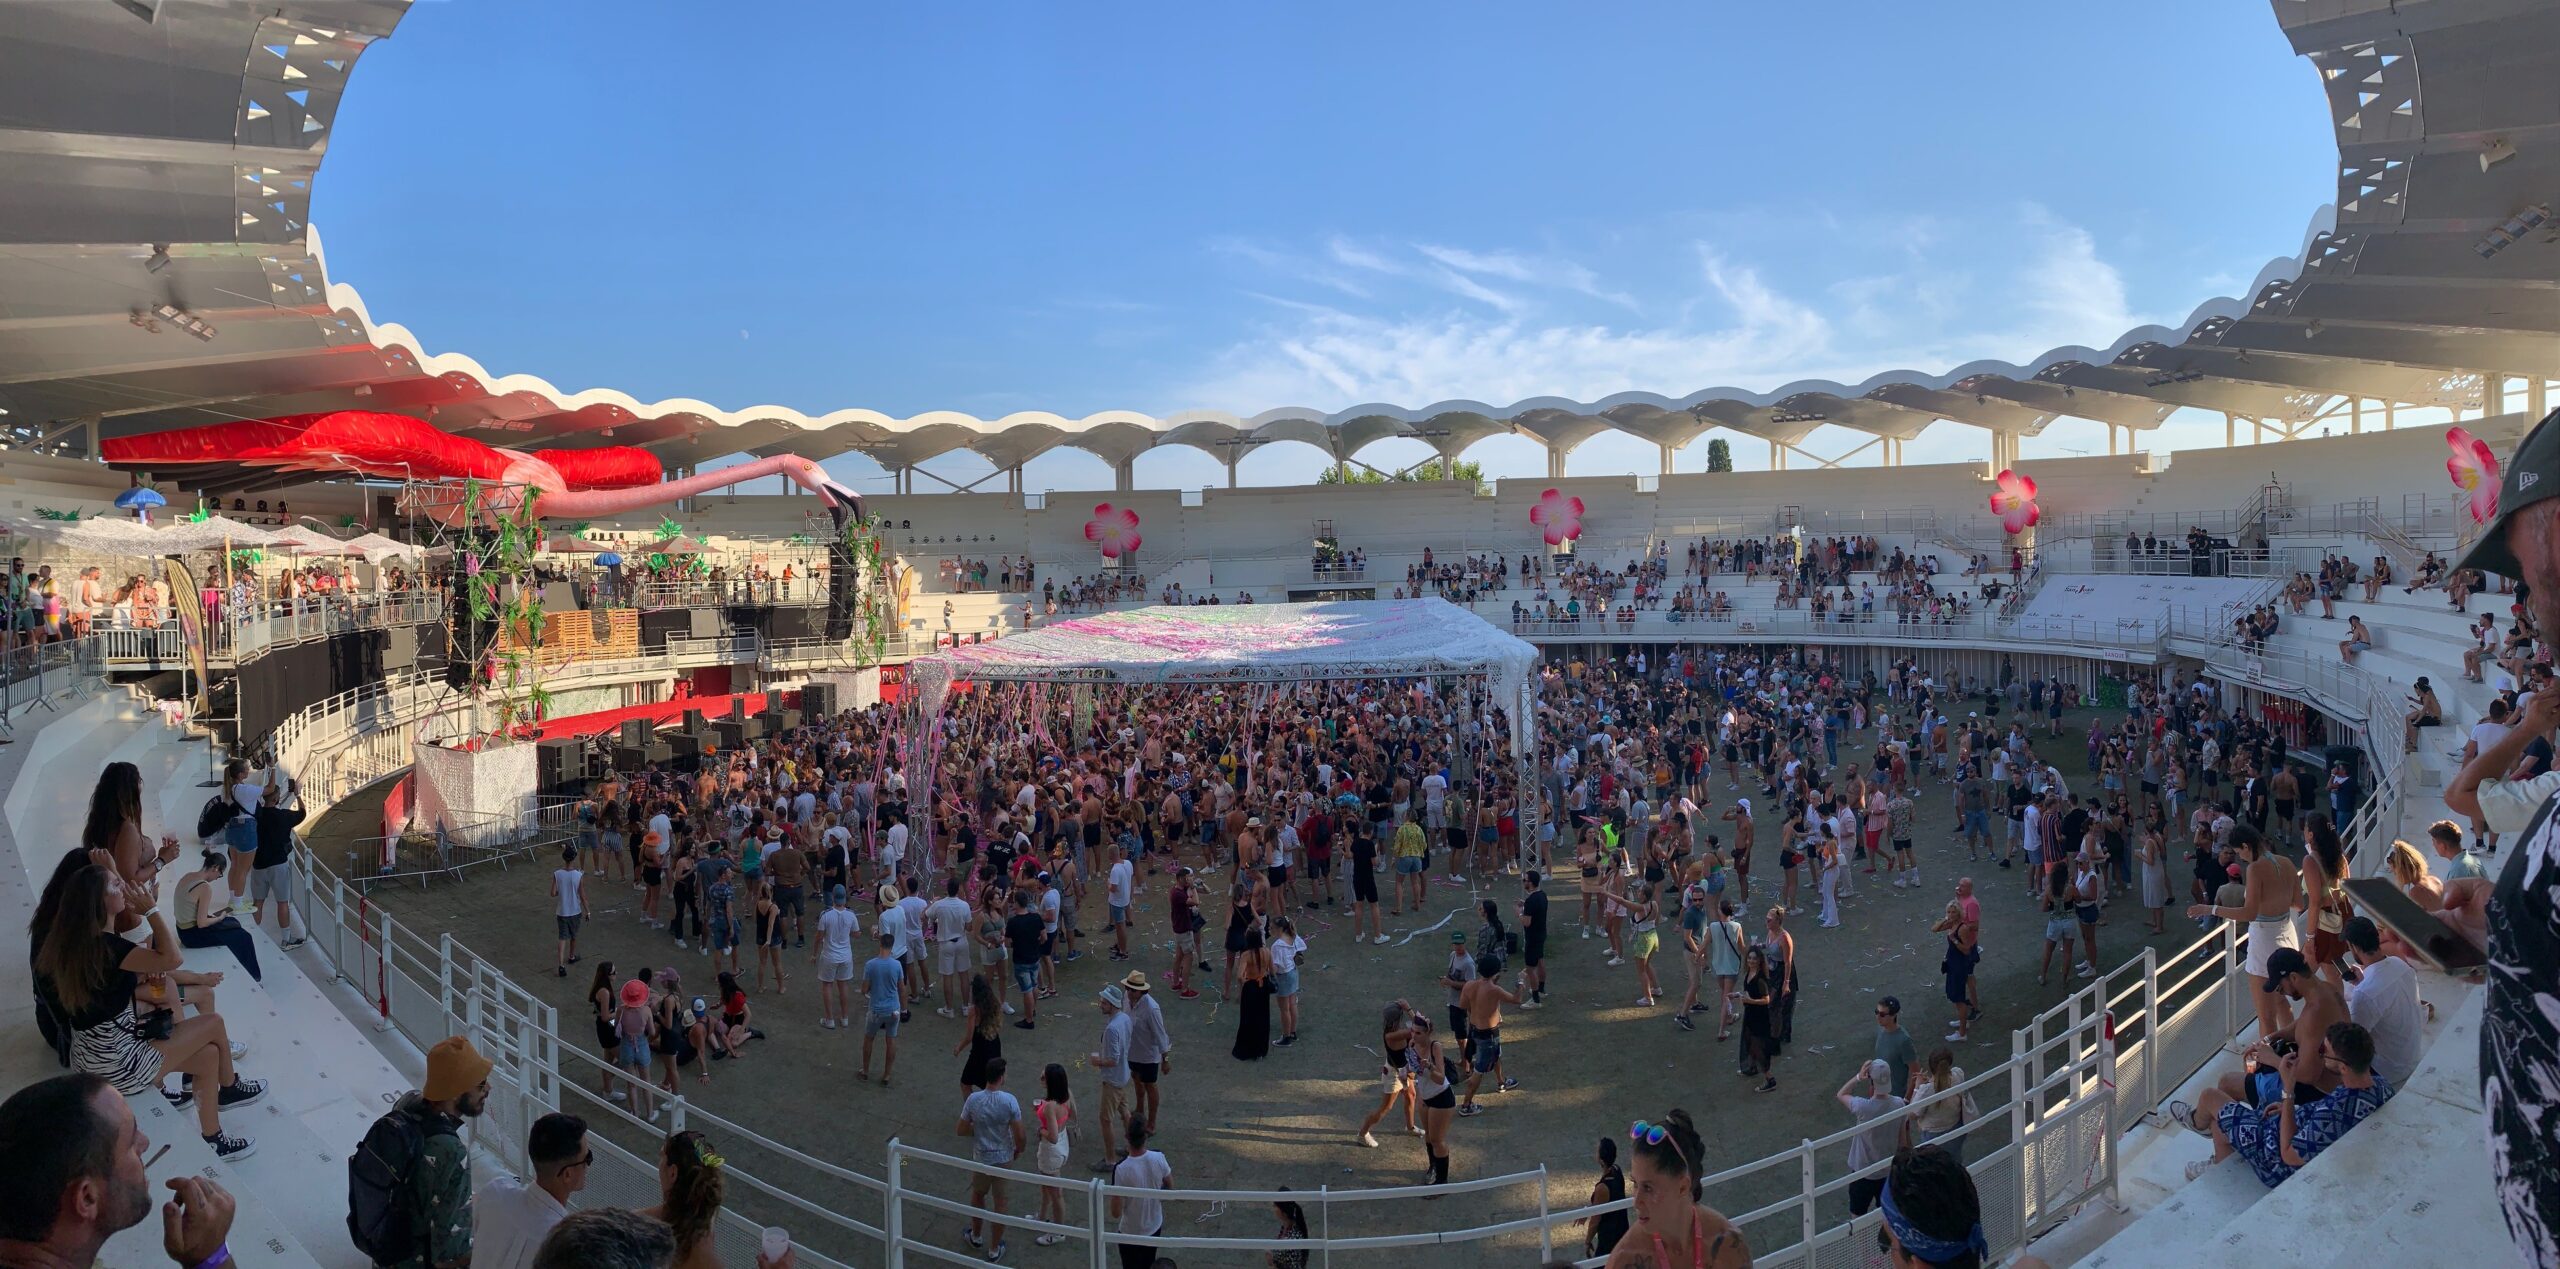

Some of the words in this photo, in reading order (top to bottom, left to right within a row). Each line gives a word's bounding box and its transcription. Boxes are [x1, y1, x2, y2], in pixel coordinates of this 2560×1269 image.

[938, 632, 952, 646] NRJ
[960, 632, 973, 646] NRJ
[2104, 651, 2125, 659] BANQUE
